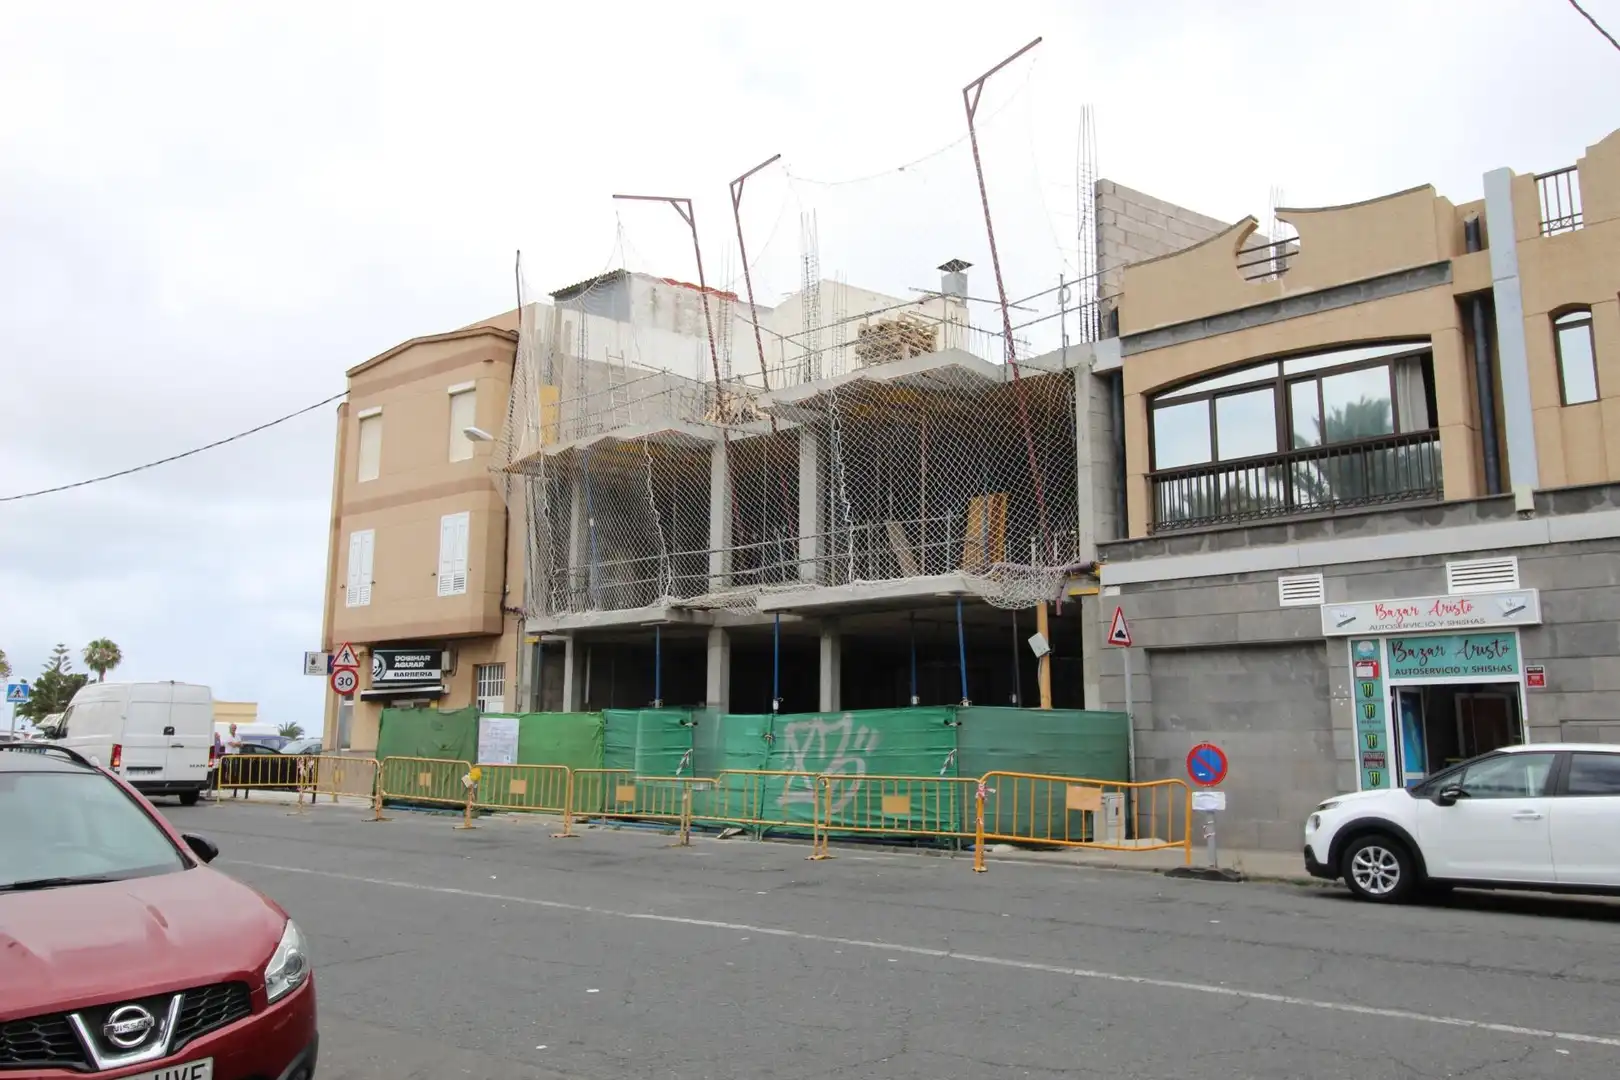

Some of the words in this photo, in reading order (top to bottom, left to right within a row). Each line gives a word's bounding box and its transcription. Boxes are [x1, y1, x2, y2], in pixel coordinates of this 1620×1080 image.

[1375, 603, 1419, 624] Bazar
[1369, 620, 1436, 631] AUTOSERVICIO
[1447, 617, 1485, 626] SHISHAS
[1392, 640, 1445, 666] Bazar
[1395, 666, 1461, 676] AUTOSERVICIO
[1464, 666, 1469, 674] Y
[1471, 664, 1513, 674] SHISHAS
[337, 677, 353, 687] 30
[113, 1019, 153, 1033] NISSAN
